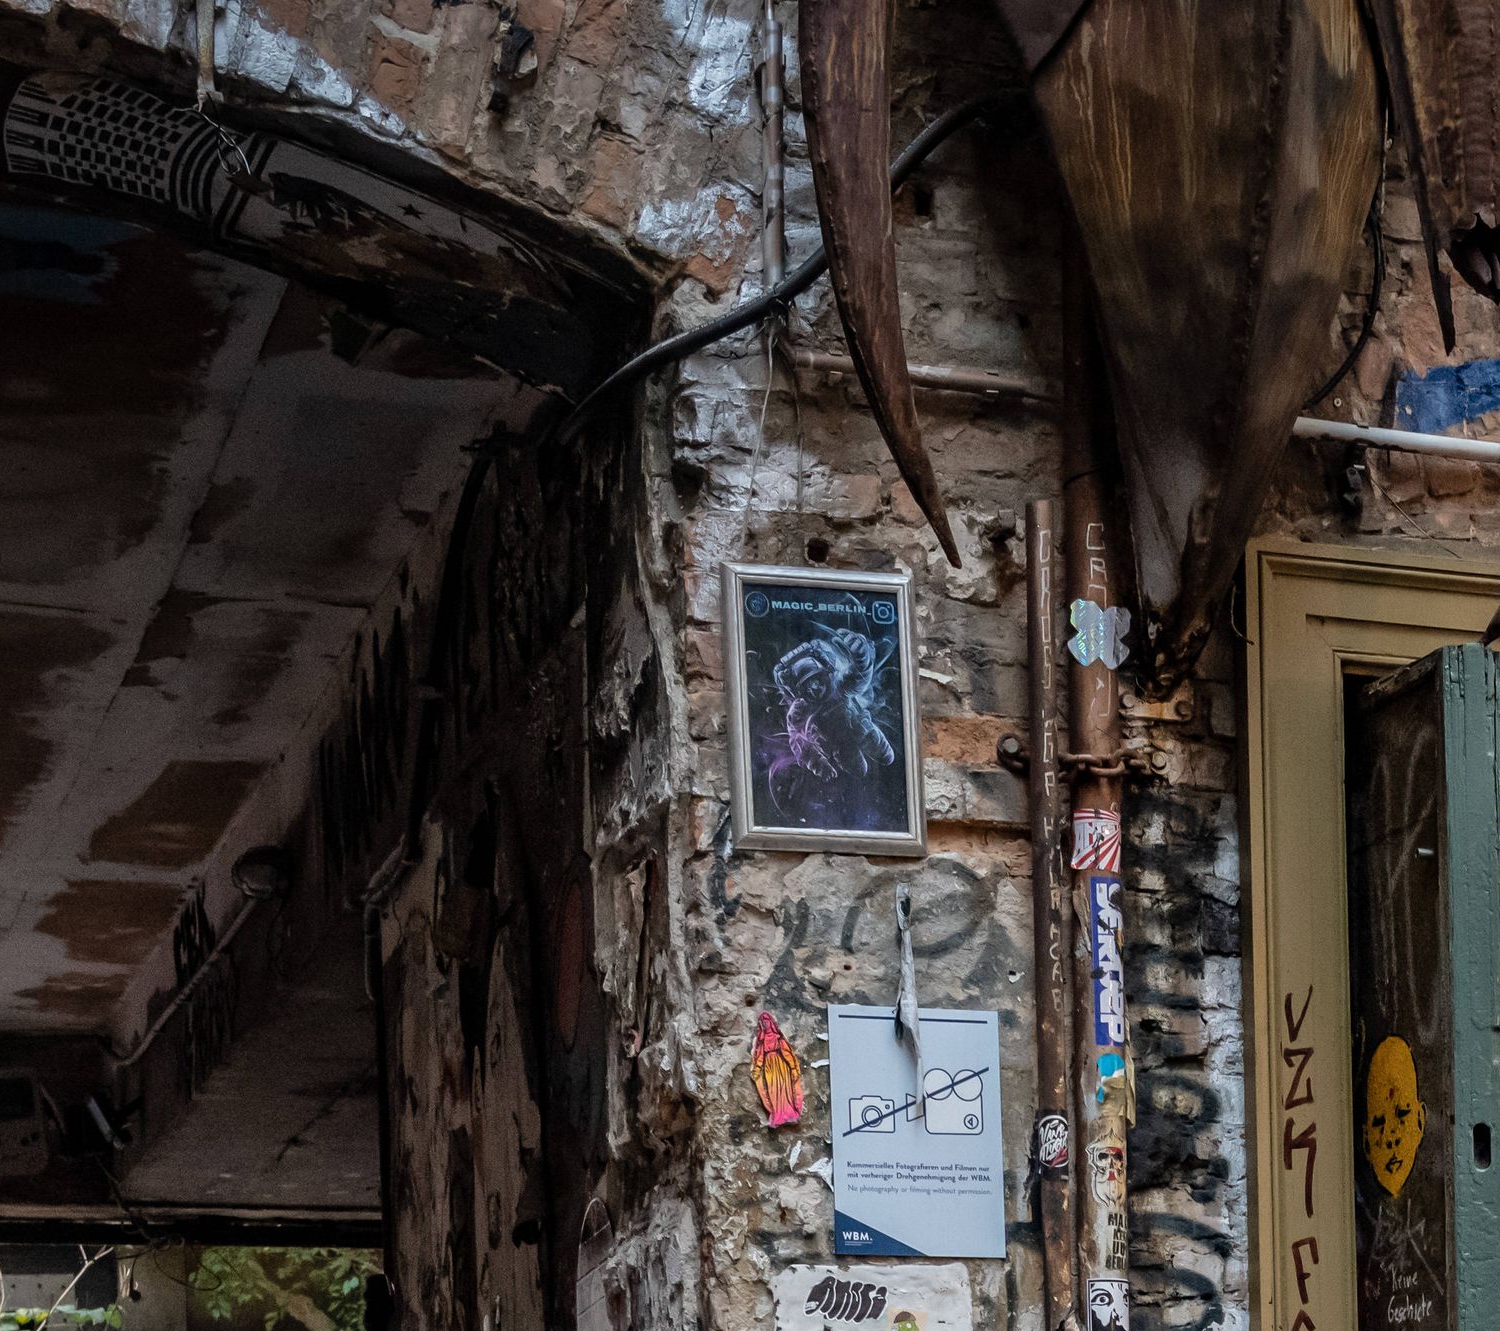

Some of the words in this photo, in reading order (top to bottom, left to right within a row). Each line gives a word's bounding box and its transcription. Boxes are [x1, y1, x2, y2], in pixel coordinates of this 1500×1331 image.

[896, 1162, 939, 1172] Fotografieren
[955, 1164, 977, 1172] Filmen
[861, 1172, 894, 1182] vorheriger
[896, 1172, 956, 1183] Drehgenehmigung
[958, 1174, 968, 1182] der
[842, 1231, 873, 1241] WBM.
